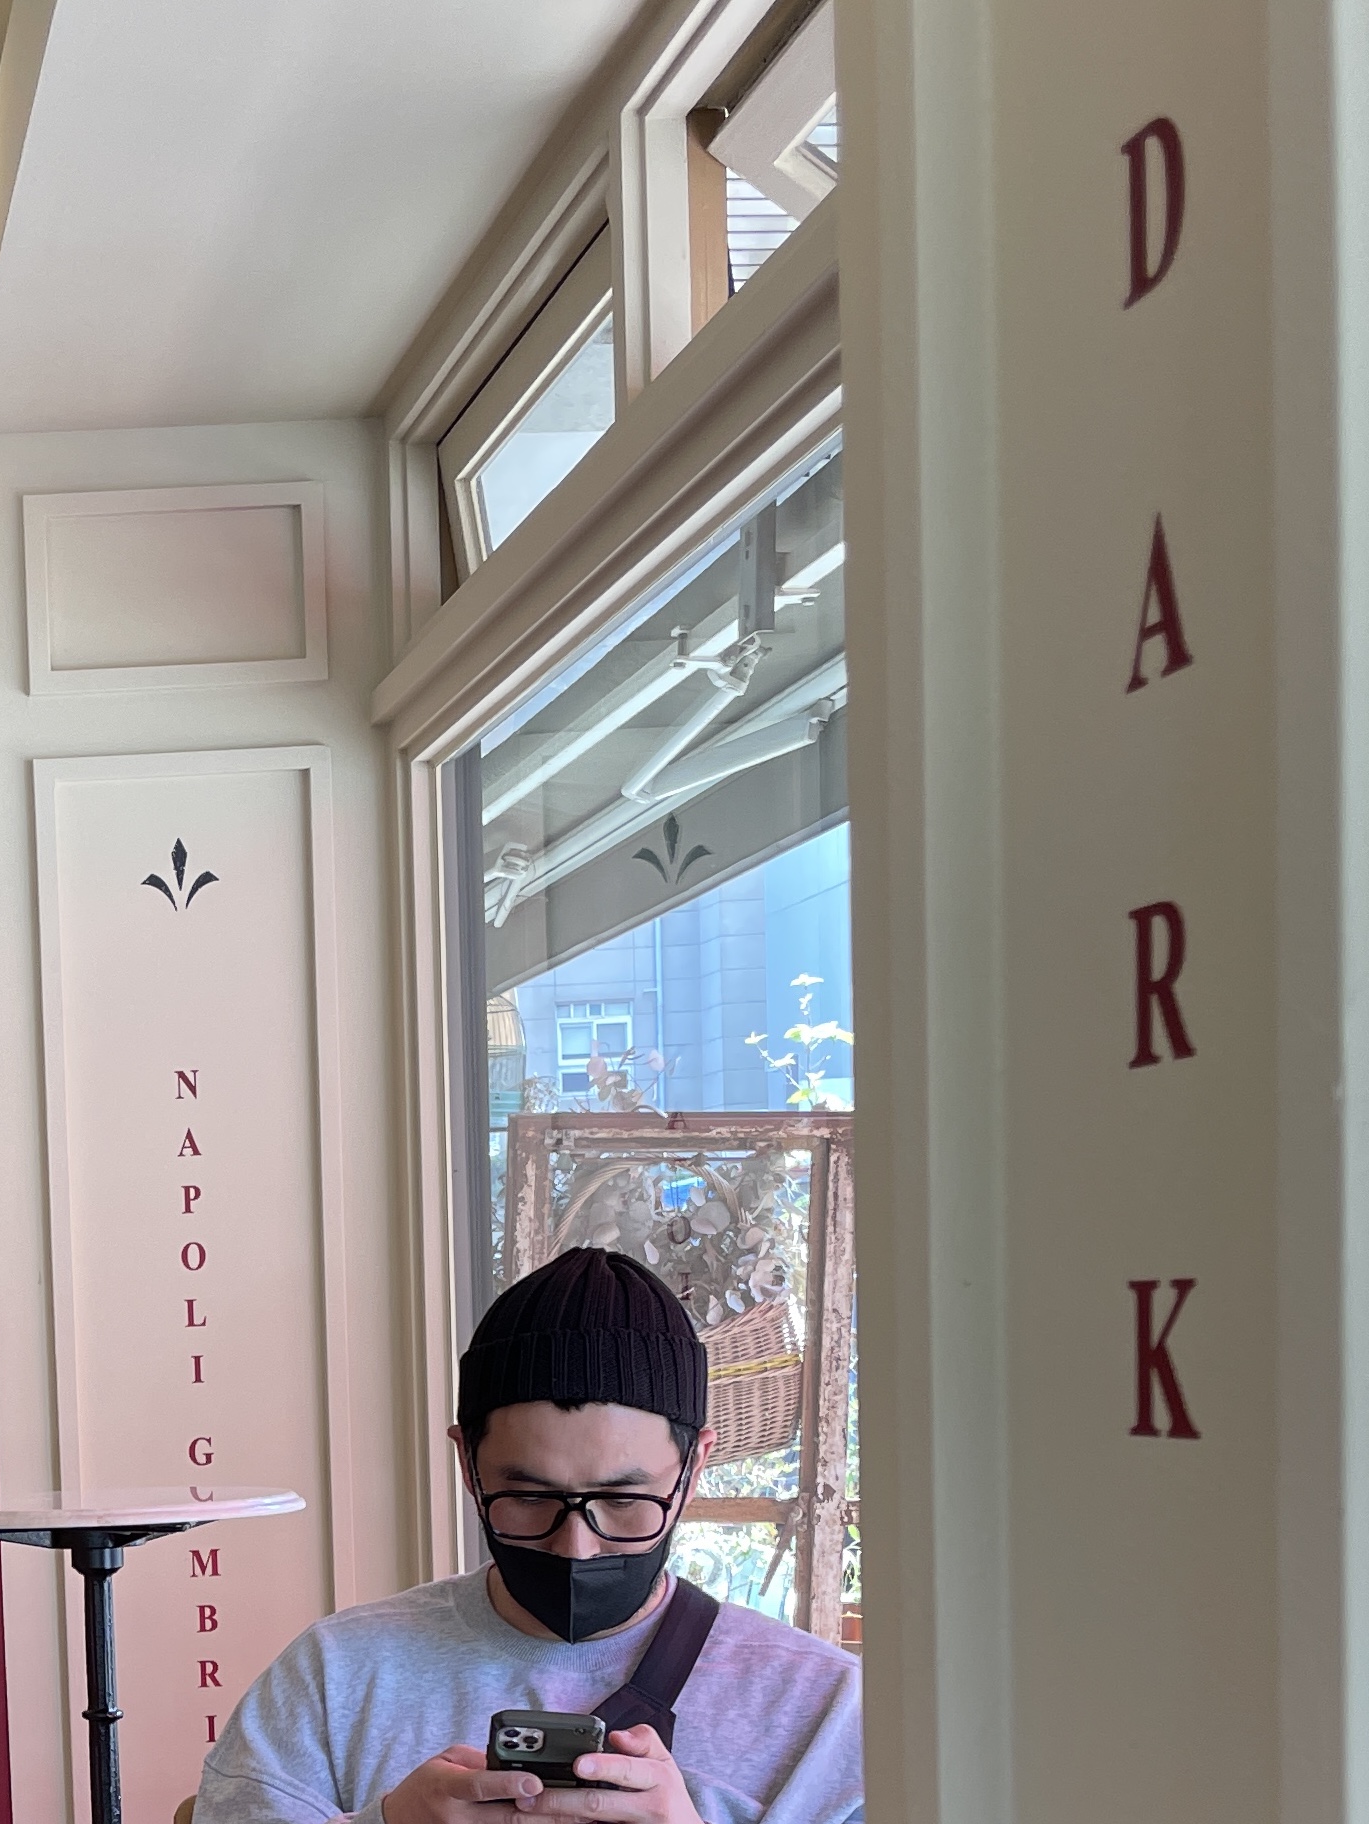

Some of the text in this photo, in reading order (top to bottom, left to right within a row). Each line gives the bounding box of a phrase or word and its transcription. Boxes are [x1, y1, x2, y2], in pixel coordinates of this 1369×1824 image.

[1120, 117, 1202, 1441] DARK
[174, 1069, 223, 1744] NAPOLI GMBRI
